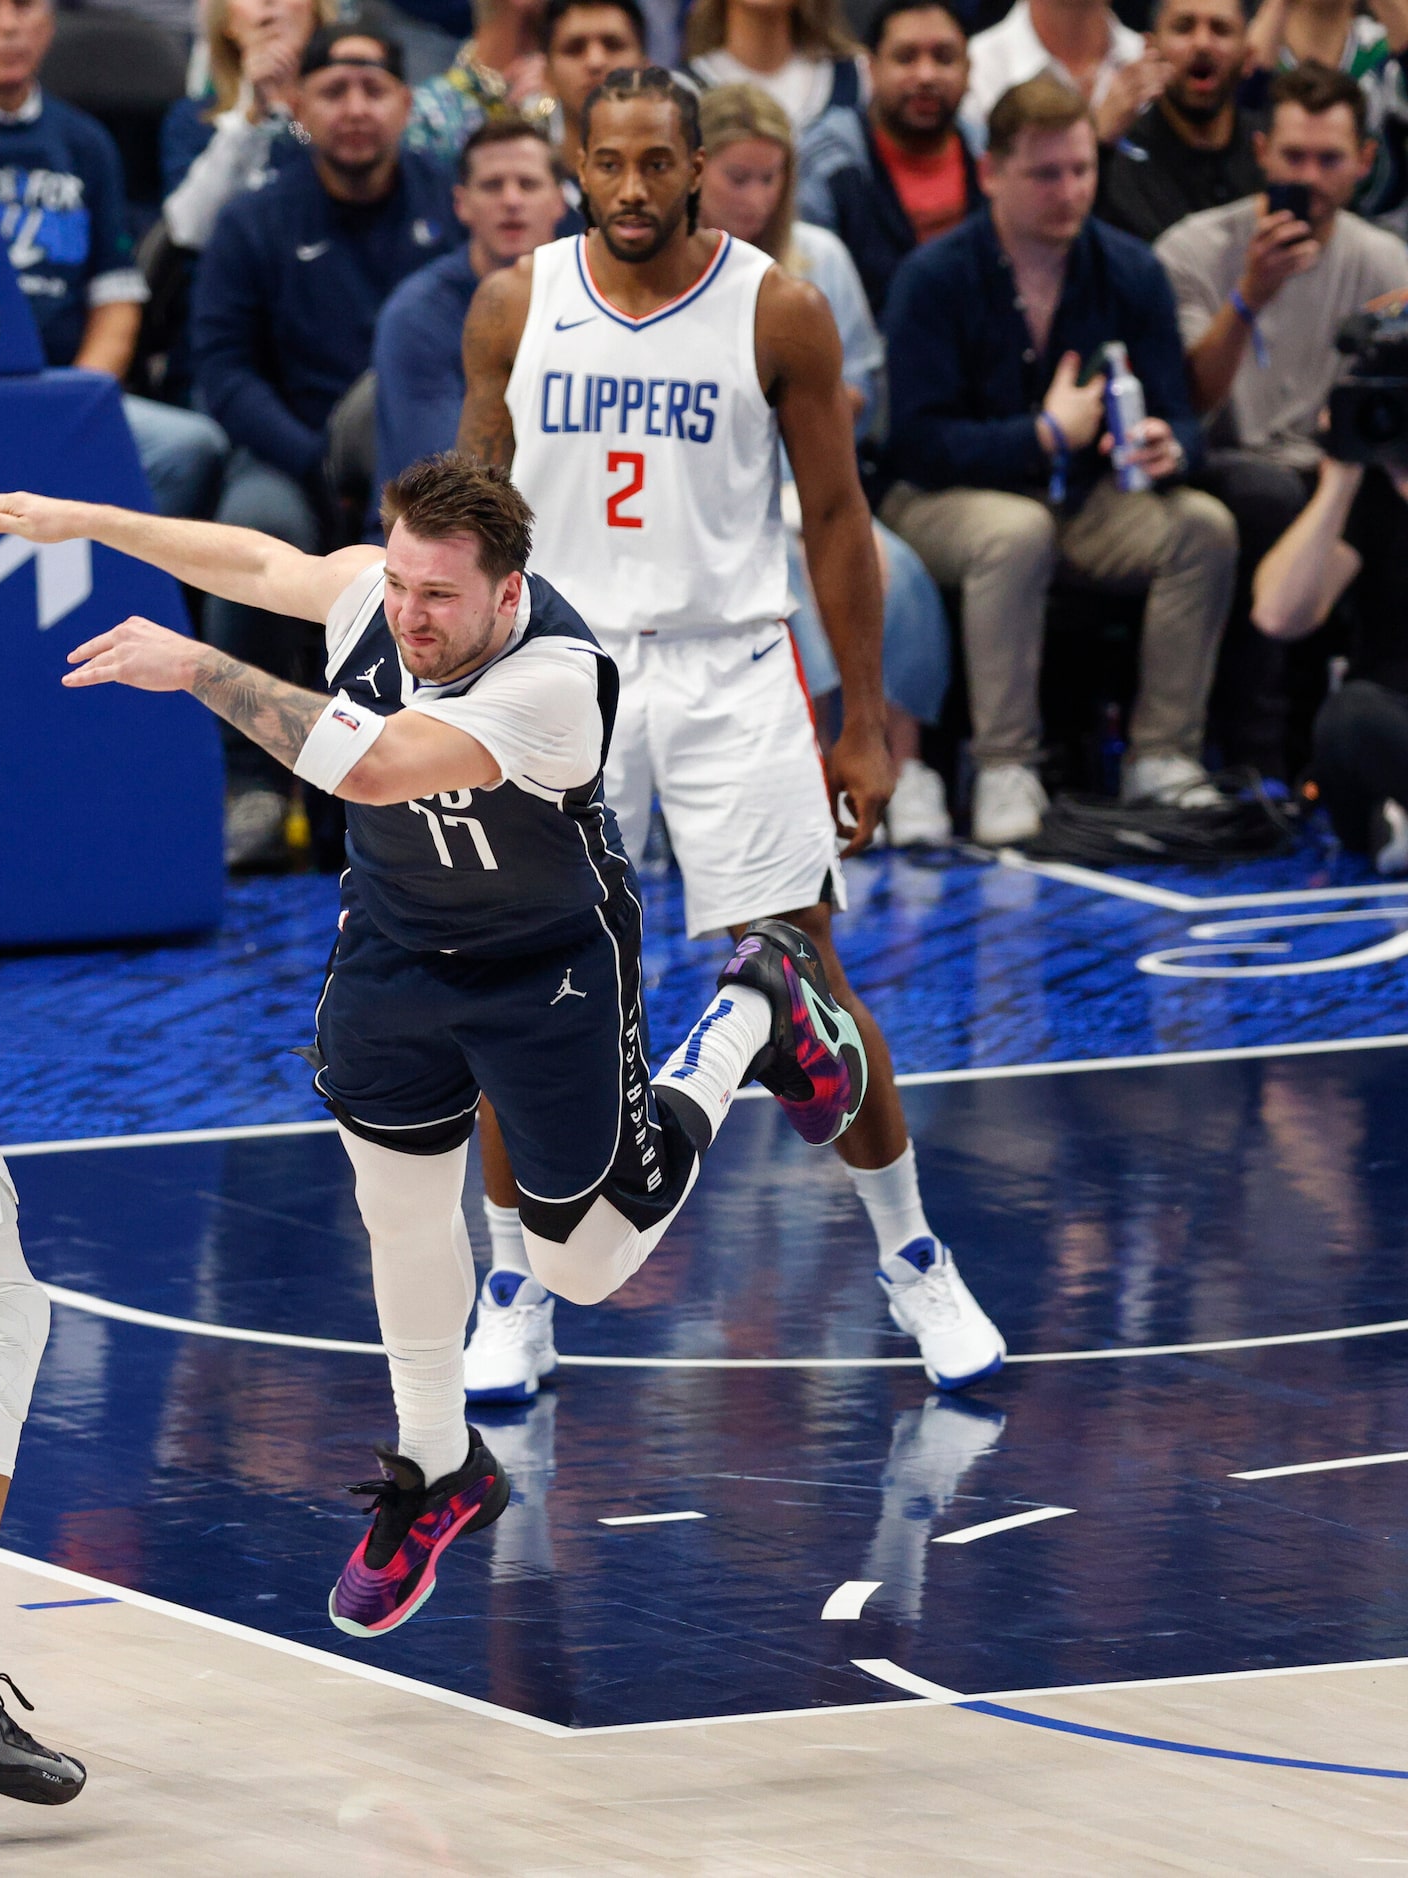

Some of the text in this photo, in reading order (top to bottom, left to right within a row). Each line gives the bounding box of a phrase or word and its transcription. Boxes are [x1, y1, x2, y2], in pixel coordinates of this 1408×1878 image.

[541, 370, 719, 444] CLIPPERS
[606, 451, 645, 529] 2
[407, 800, 499, 871] 77
